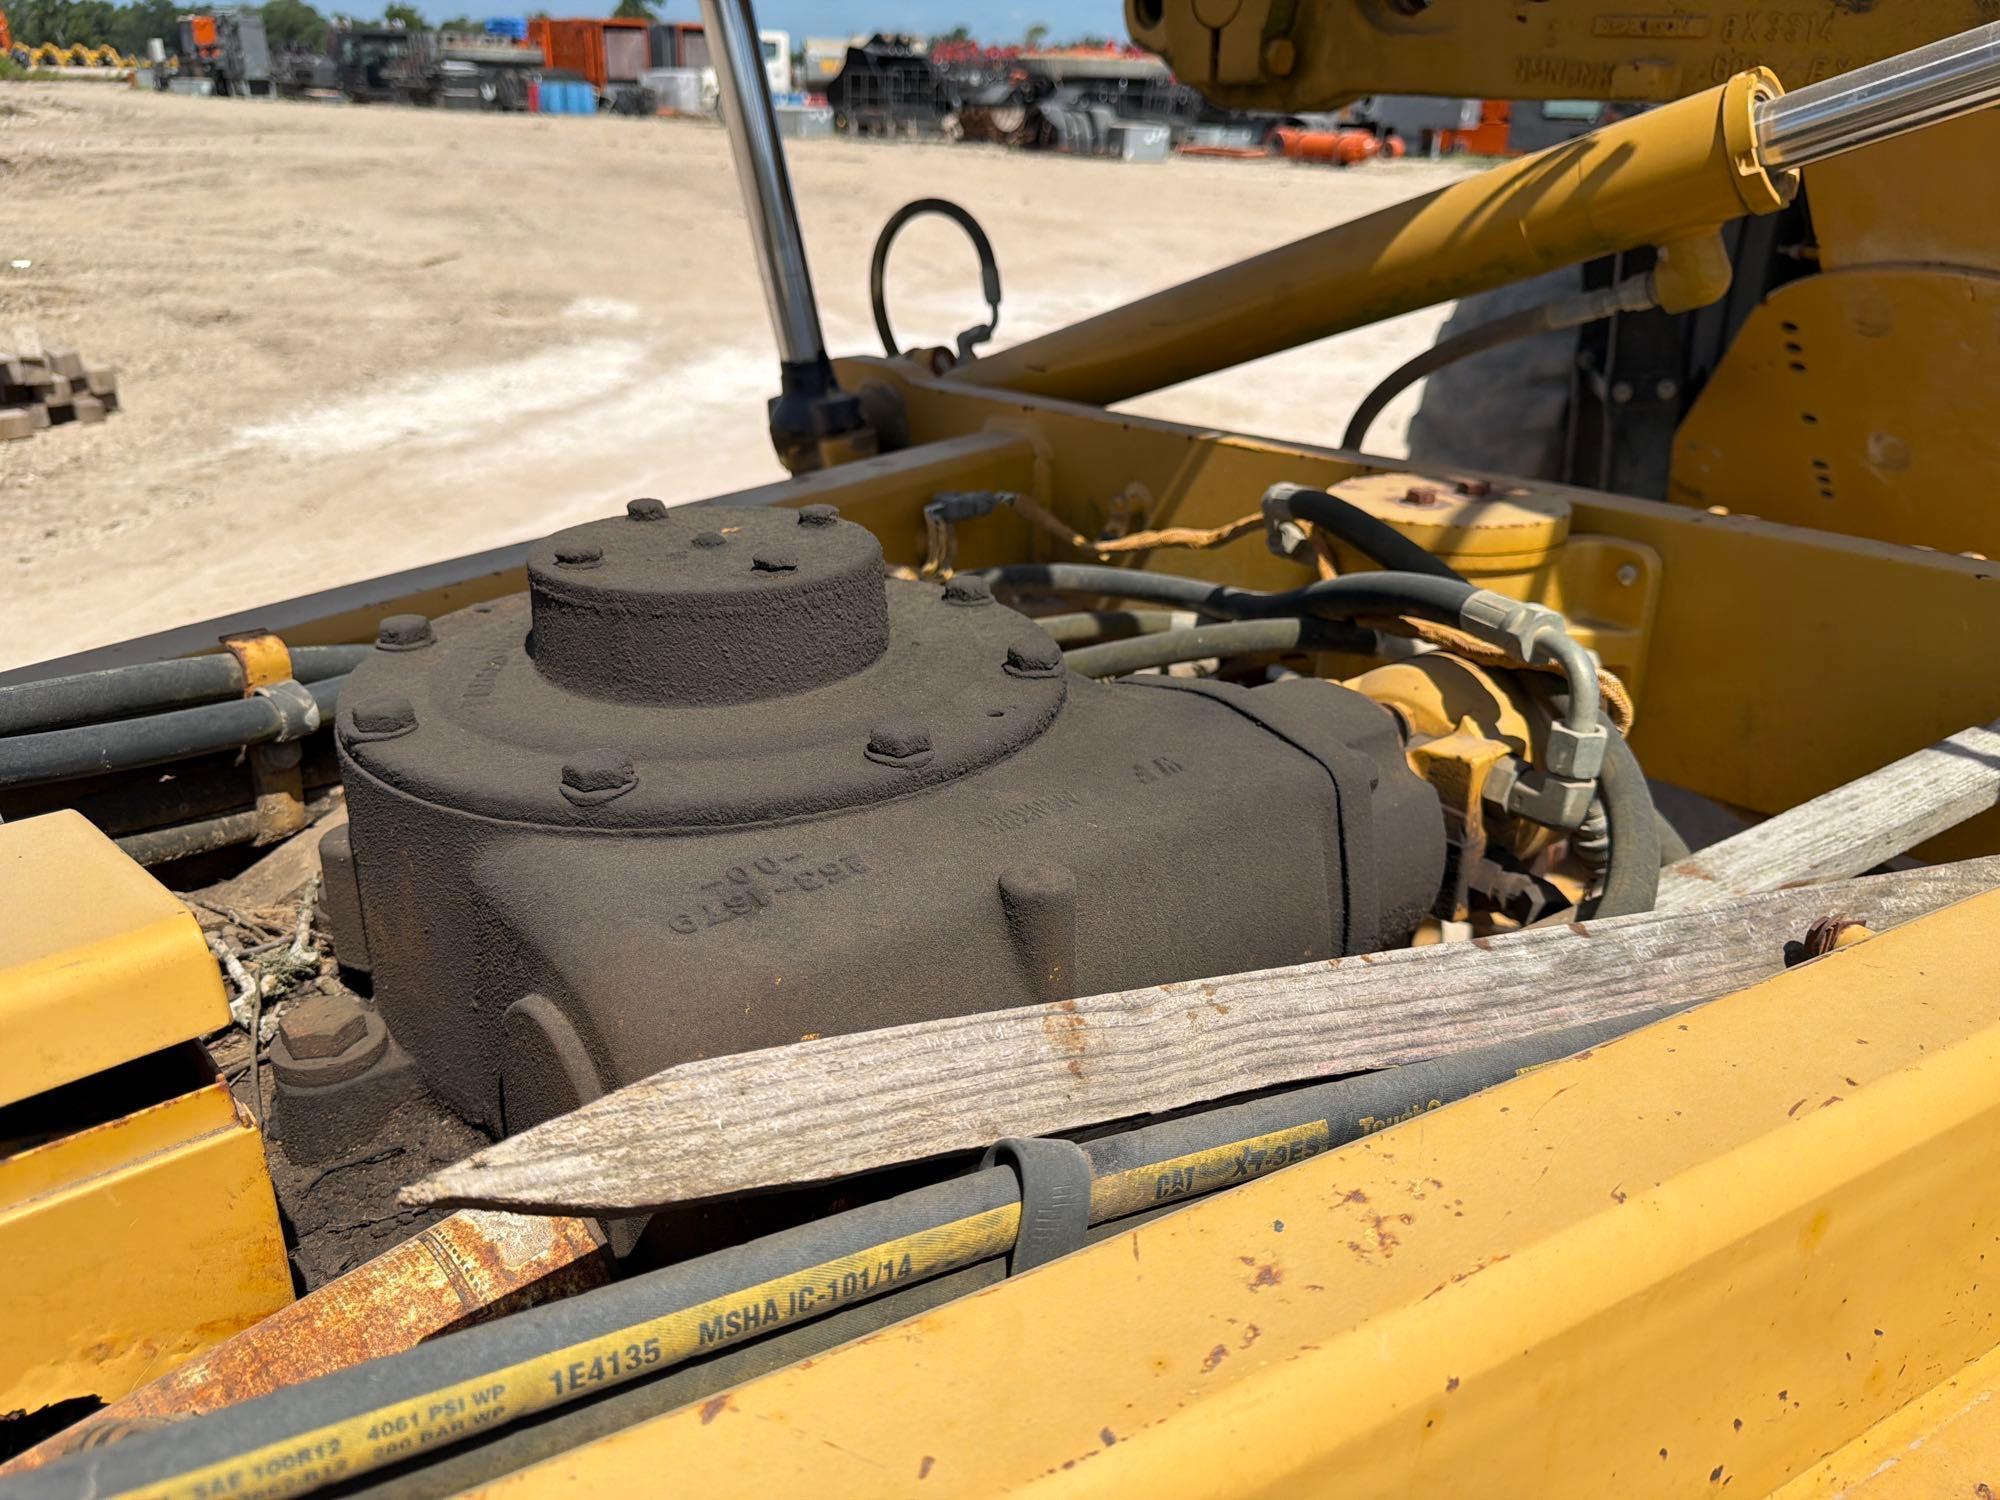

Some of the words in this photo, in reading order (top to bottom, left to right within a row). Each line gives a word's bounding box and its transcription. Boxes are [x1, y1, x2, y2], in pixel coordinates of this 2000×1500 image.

[1156, 1166, 1195, 1200] CAT
[549, 1337, 661, 1395] 1E4135
[698, 1298, 779, 1346] MSHA
[368, 1410, 419, 1440] 4061
[429, 1396, 465, 1420] PSI
[471, 1384, 506, 1406] WP
